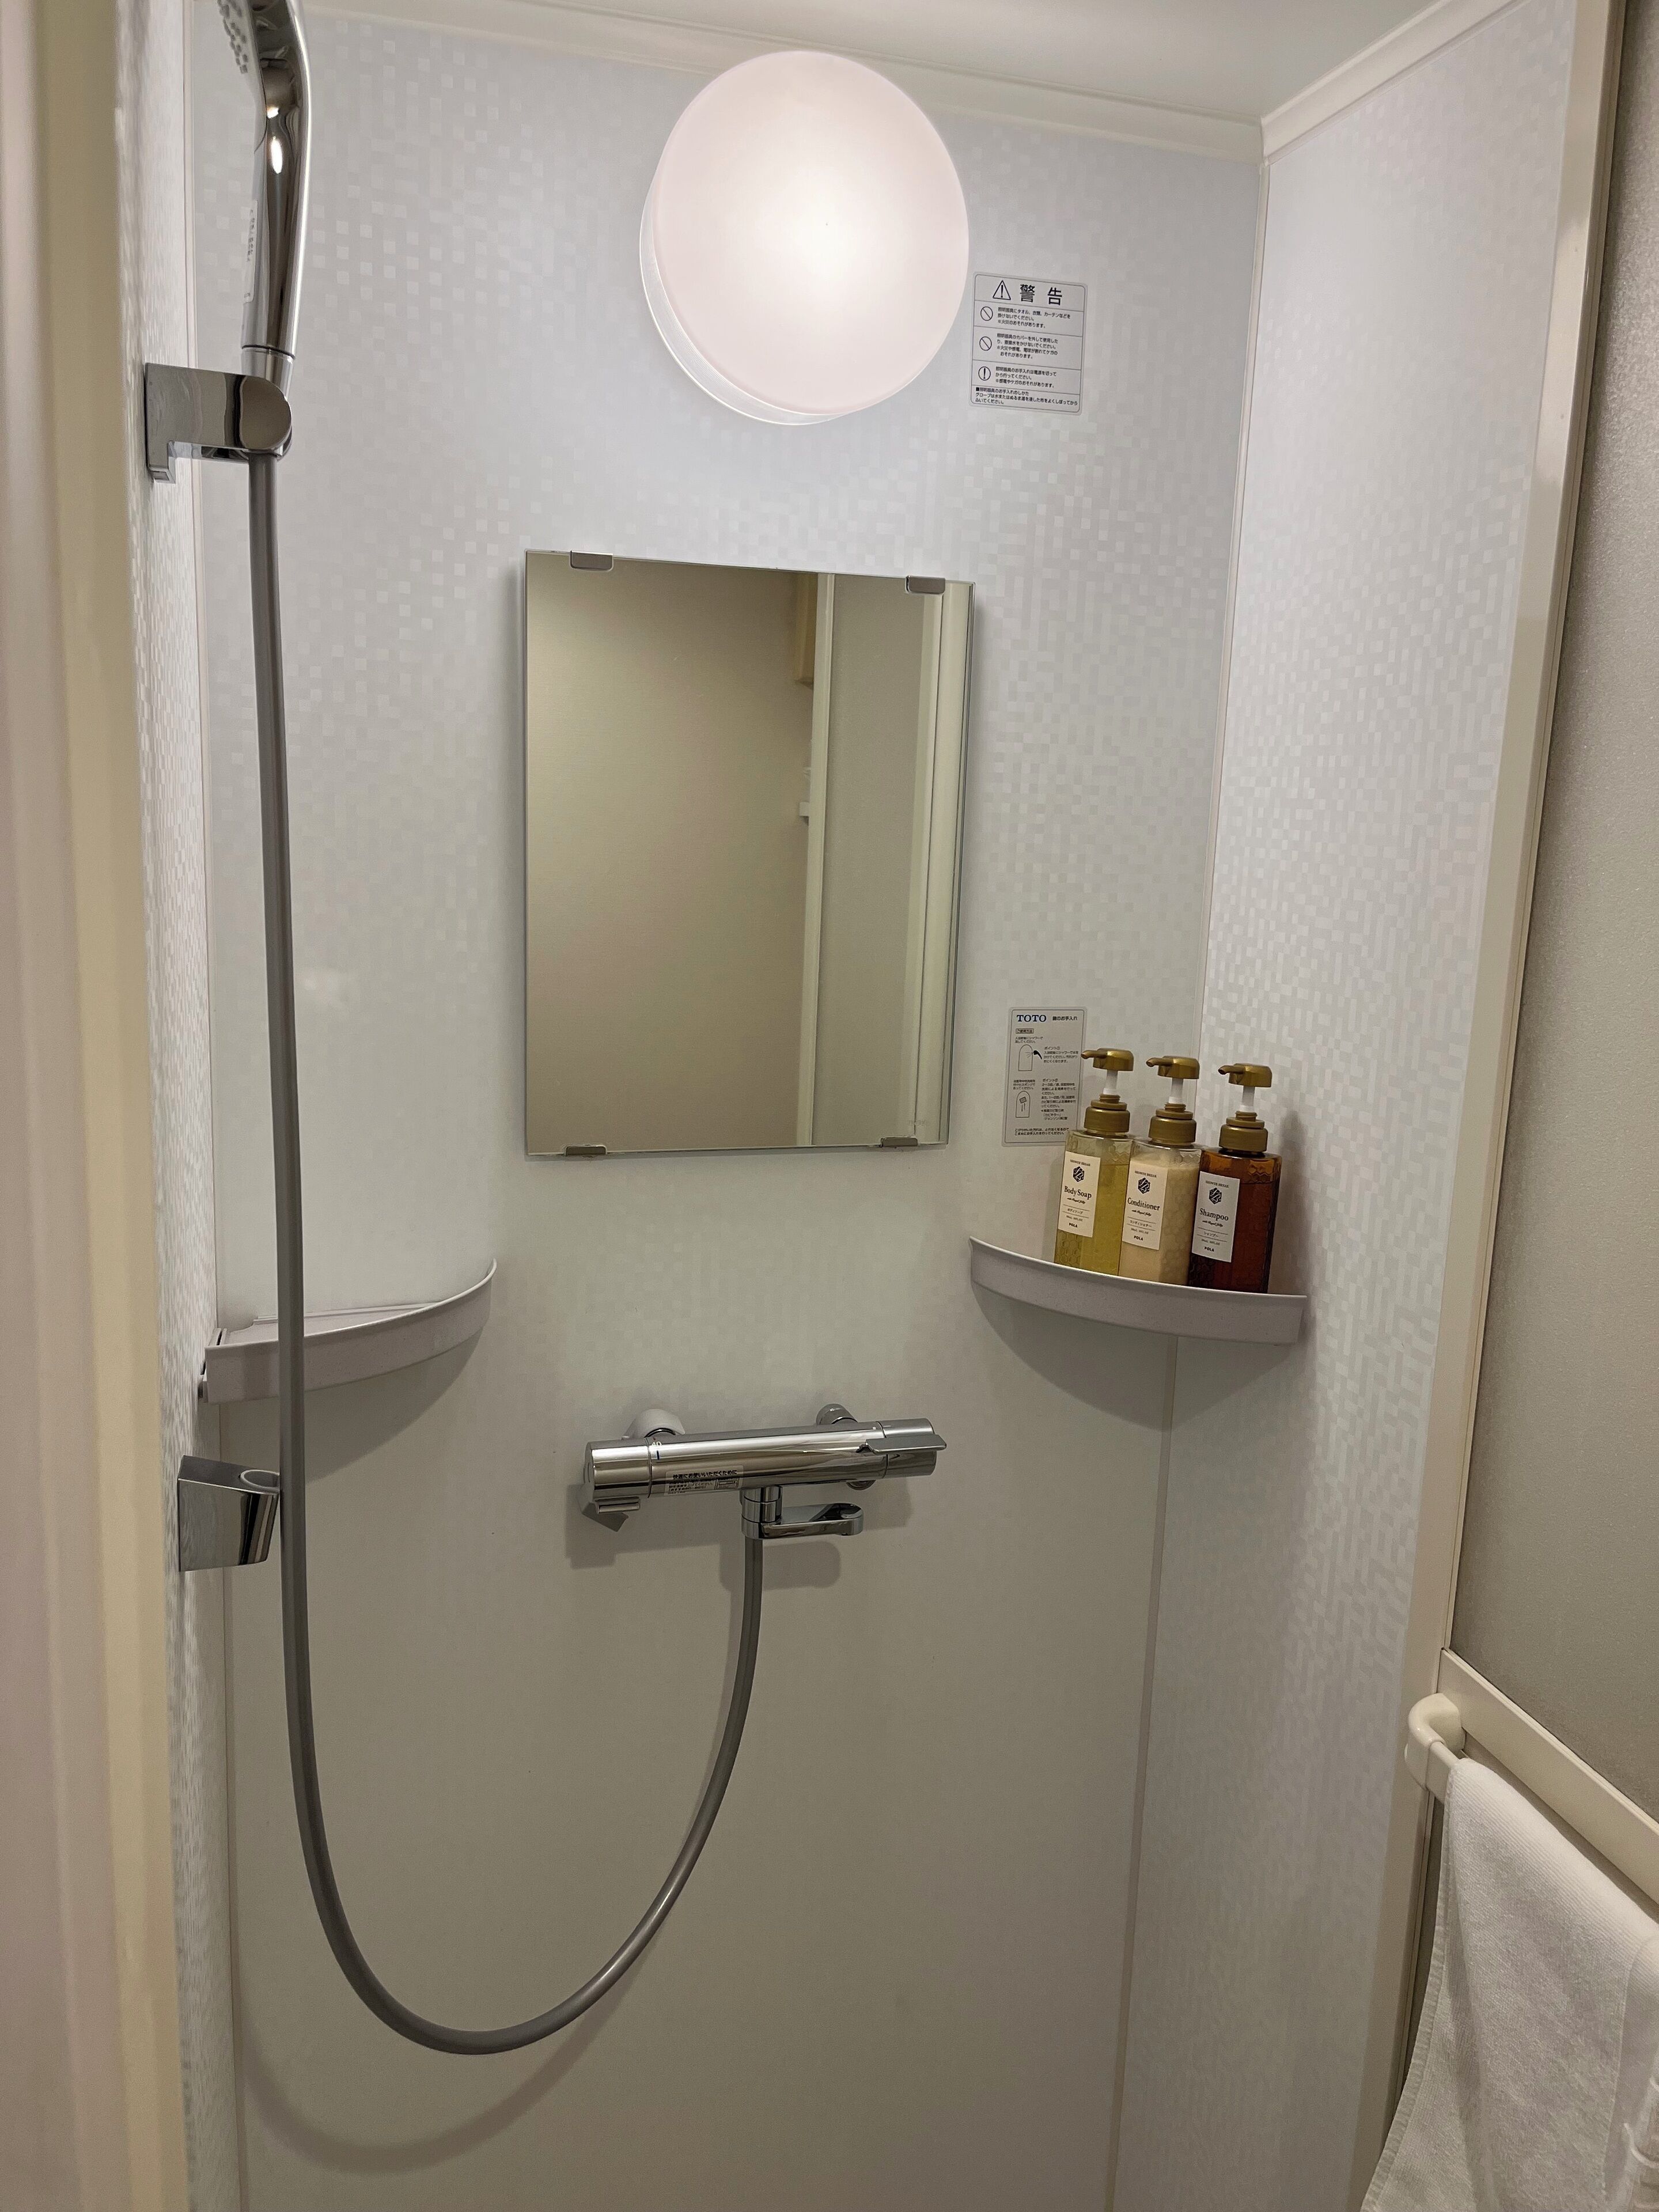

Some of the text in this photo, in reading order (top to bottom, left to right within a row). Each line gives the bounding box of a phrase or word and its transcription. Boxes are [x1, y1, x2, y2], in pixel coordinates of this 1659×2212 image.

[1020, 284, 1063, 306] 警告
[1016, 1014, 1047, 1022] TOTO
[1064, 1185, 1092, 1200] Body Soap
[1127, 1197, 1160, 1211] Conditioner
[1199, 1207, 1229, 1221] Shampoo
[672, 1469, 738, 1480] 快適にお使いいただくために
